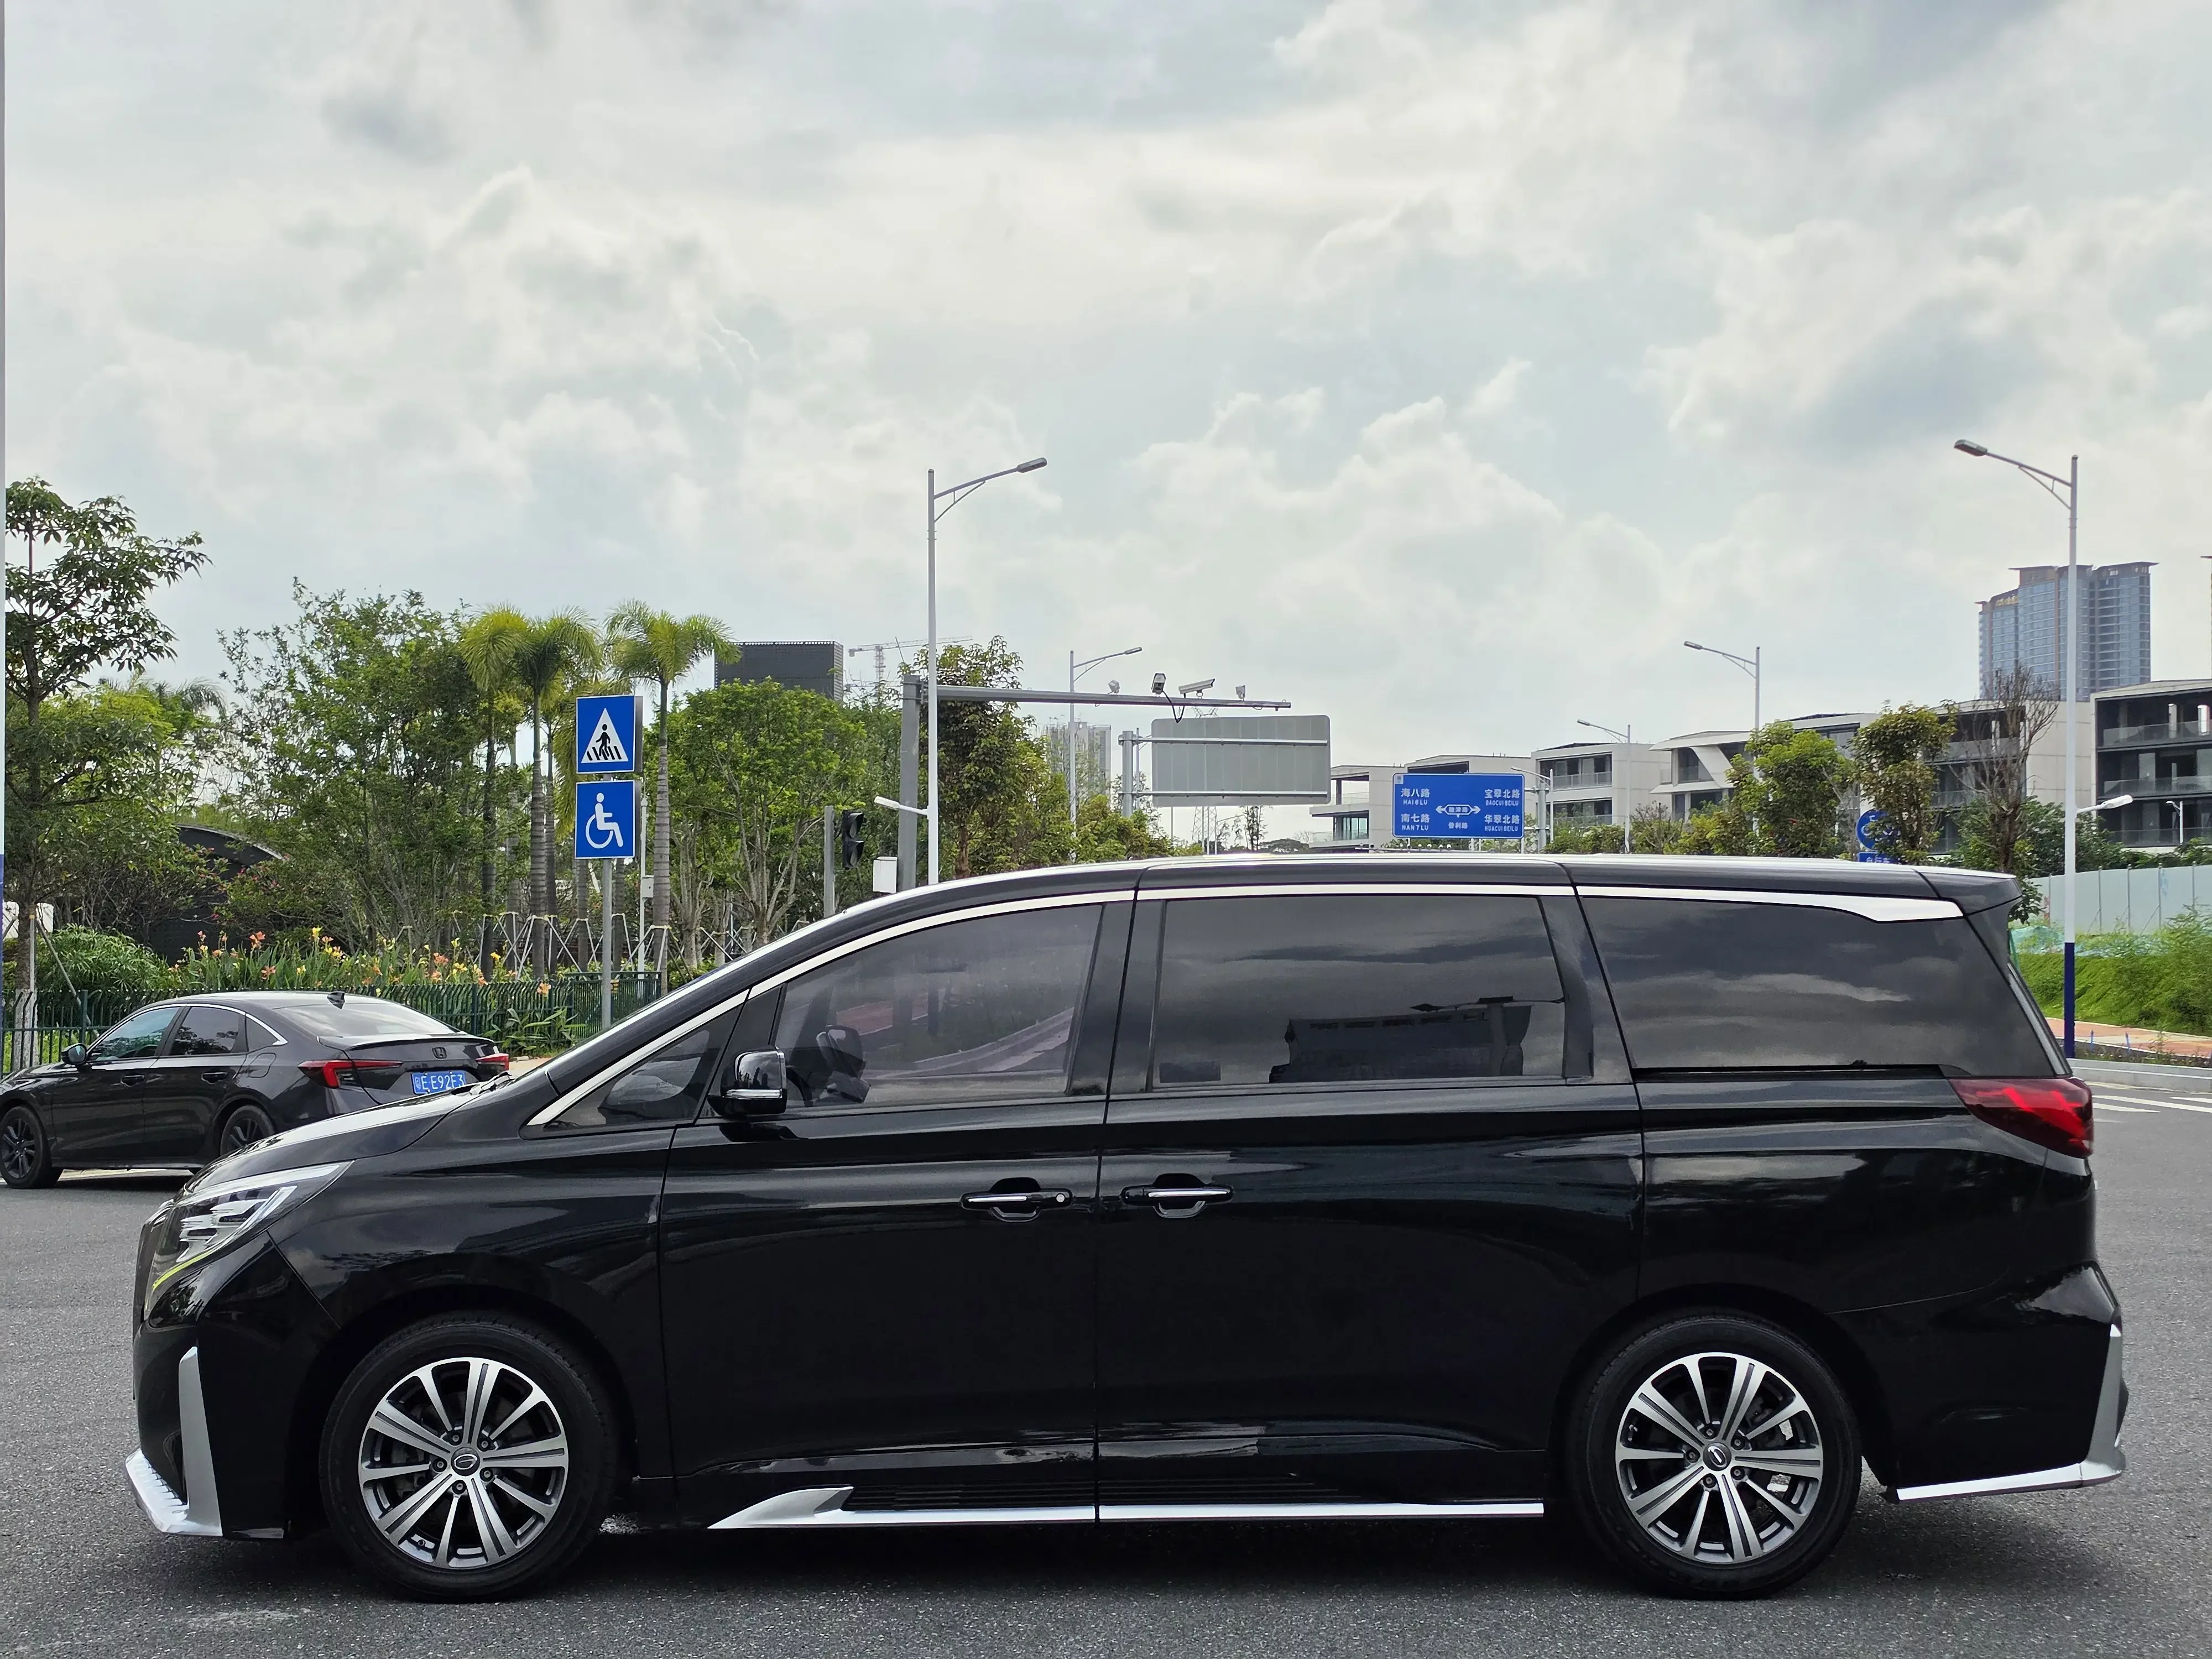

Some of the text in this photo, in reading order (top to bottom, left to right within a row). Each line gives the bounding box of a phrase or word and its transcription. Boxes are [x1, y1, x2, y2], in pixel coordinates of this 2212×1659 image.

[1401, 788, 1430, 797] 海八路
[1484, 789, 1520, 798] 宝翠北路
[1401, 813, 1430, 823] 南七路
[1484, 814, 1520, 824] 华翠北路
